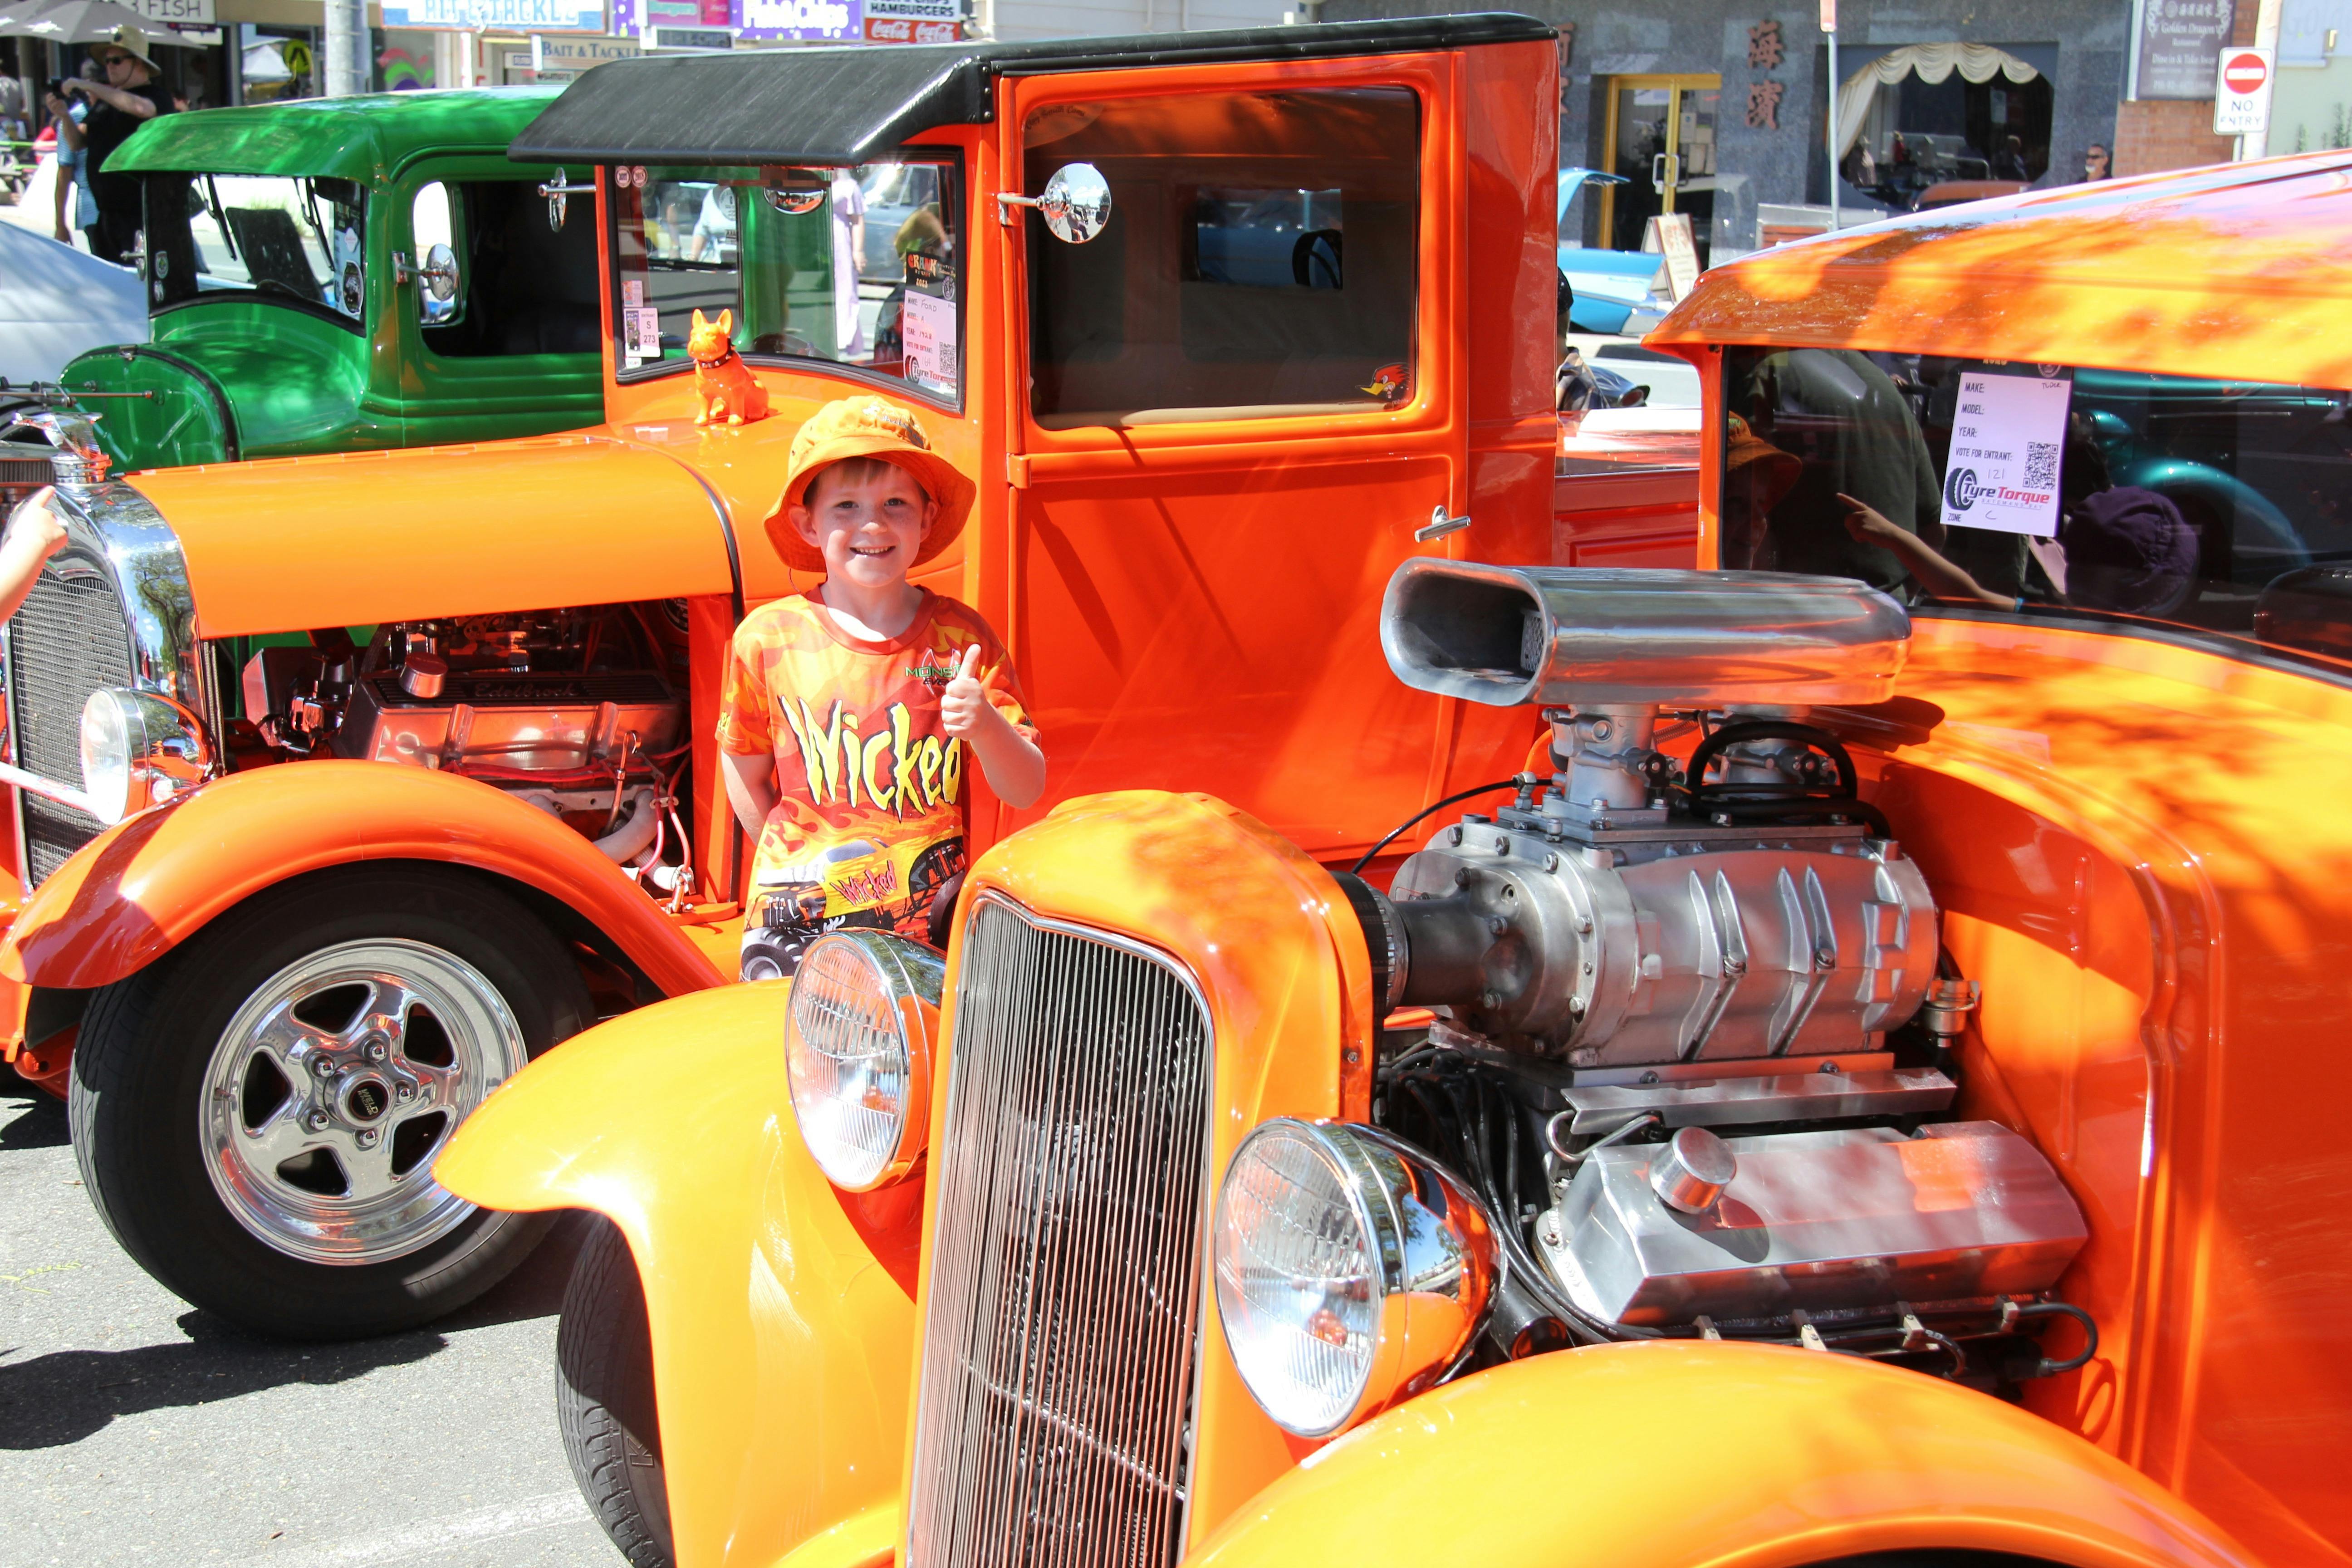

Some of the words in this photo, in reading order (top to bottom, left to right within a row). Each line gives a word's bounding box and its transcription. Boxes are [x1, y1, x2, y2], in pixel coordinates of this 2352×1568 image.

[148, 0, 201, 17] FISH
[871, 3, 954, 17] HAMBURGERS
[2161, 21, 2188, 34] Golden
[2188, 23, 2215, 38] Dragon
[542, 41, 573, 58] BAIT
[577, 47, 586, 58] &
[2232, 100, 2254, 112] NO
[908, 254, 937, 277] CRANK
[916, 278, 928, 289] 2023
[921, 299, 937, 313] FORD
[647, 320, 652, 329] S
[643, 335, 656, 343] 273
[1964, 382, 1985, 393] MAKE:
[1960, 403, 1984, 415] MODEL:
[1958, 426, 1978, 438] YEAR:
[1956, 447, 1970, 457] VOTE
[1971, 449, 1982, 458] FOR
[1984, 451, 2013, 461] ENTRANT:
[1988, 468, 2005, 480] 121
[1981, 499, 2025, 507] BATEMANS
[1947, 513, 1962, 522] ZONE
[829, 859, 898, 907] Wicked
[357, 1090, 373, 1115] RACING
[361, 1088, 379, 1114] WELD
